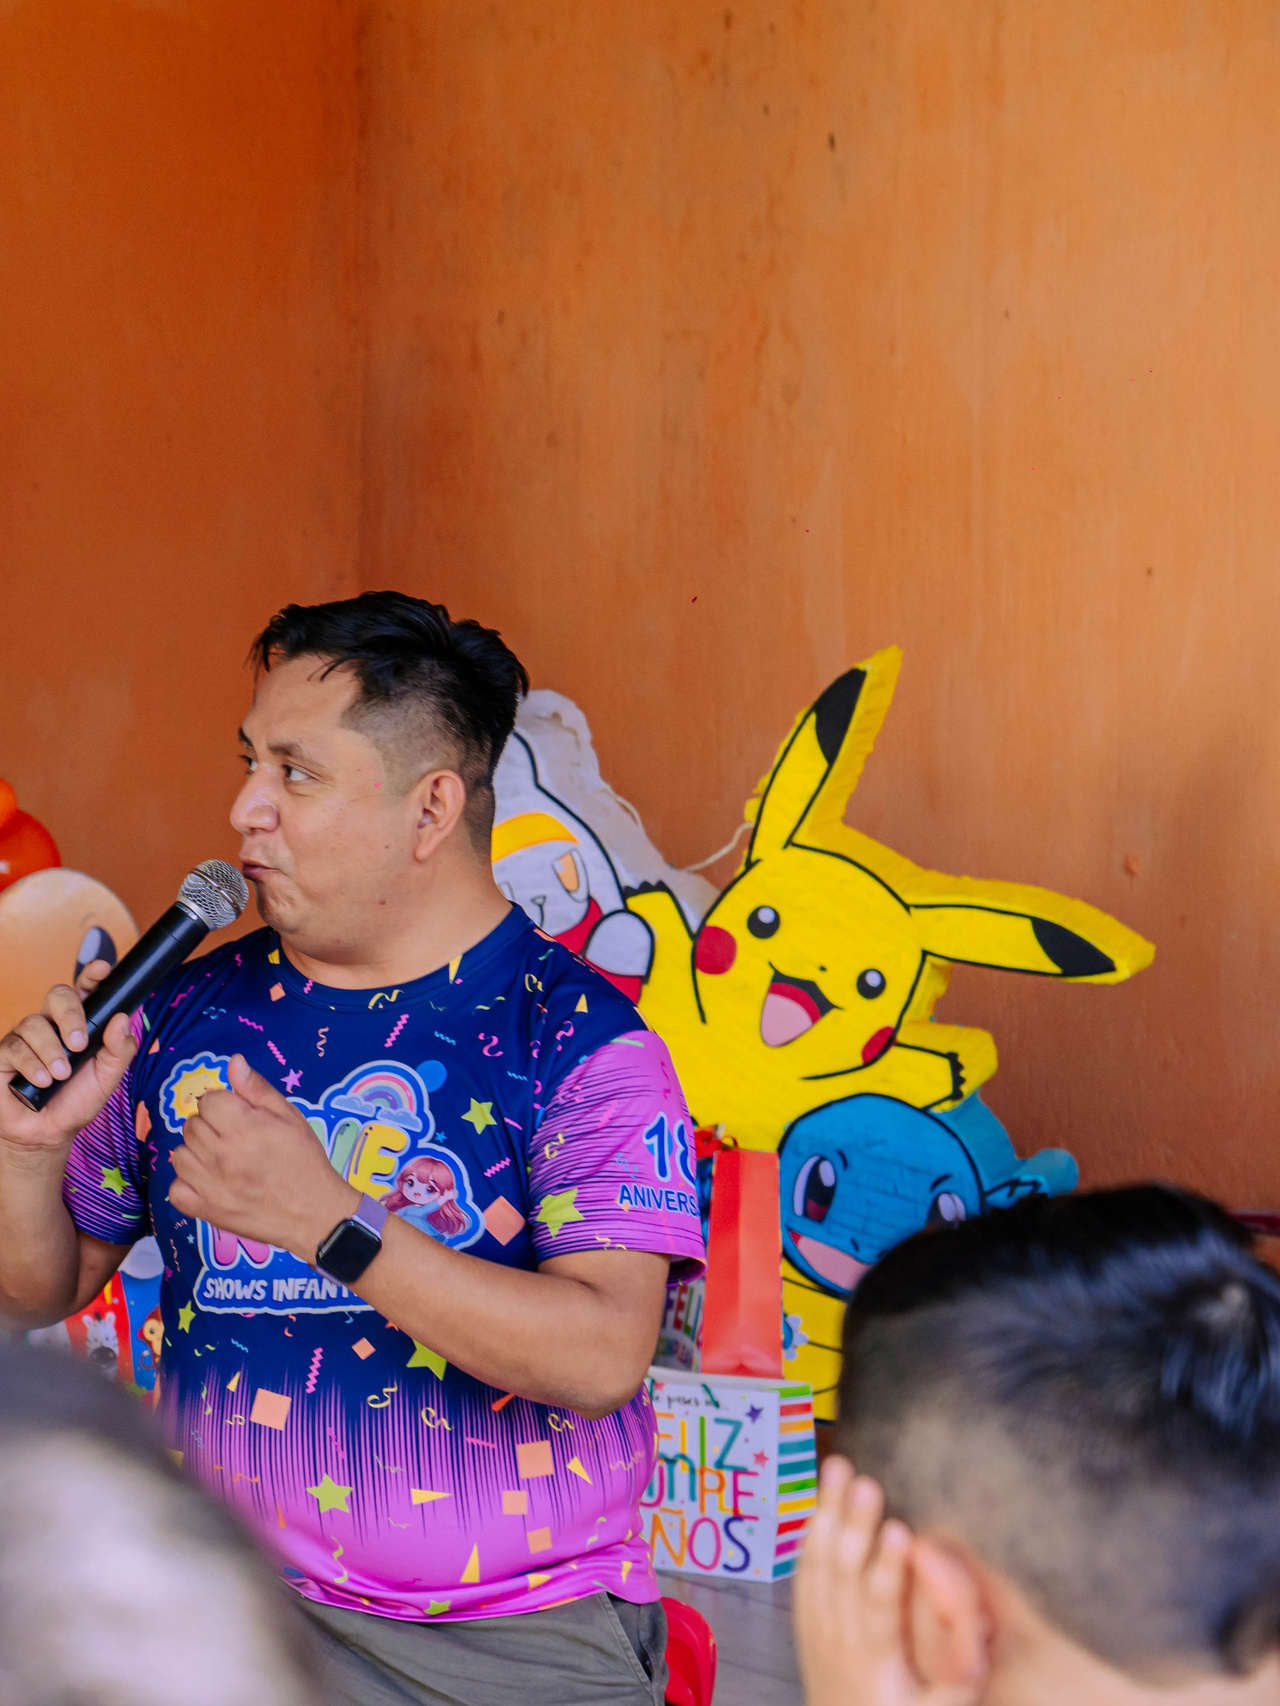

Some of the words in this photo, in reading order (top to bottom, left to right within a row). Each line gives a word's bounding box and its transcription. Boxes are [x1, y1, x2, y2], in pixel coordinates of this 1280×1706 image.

[202, 1276, 269, 1301] SHOWS
[272, 1277, 359, 1302] INFANT
[649, 1507, 751, 1574] ÑOS
